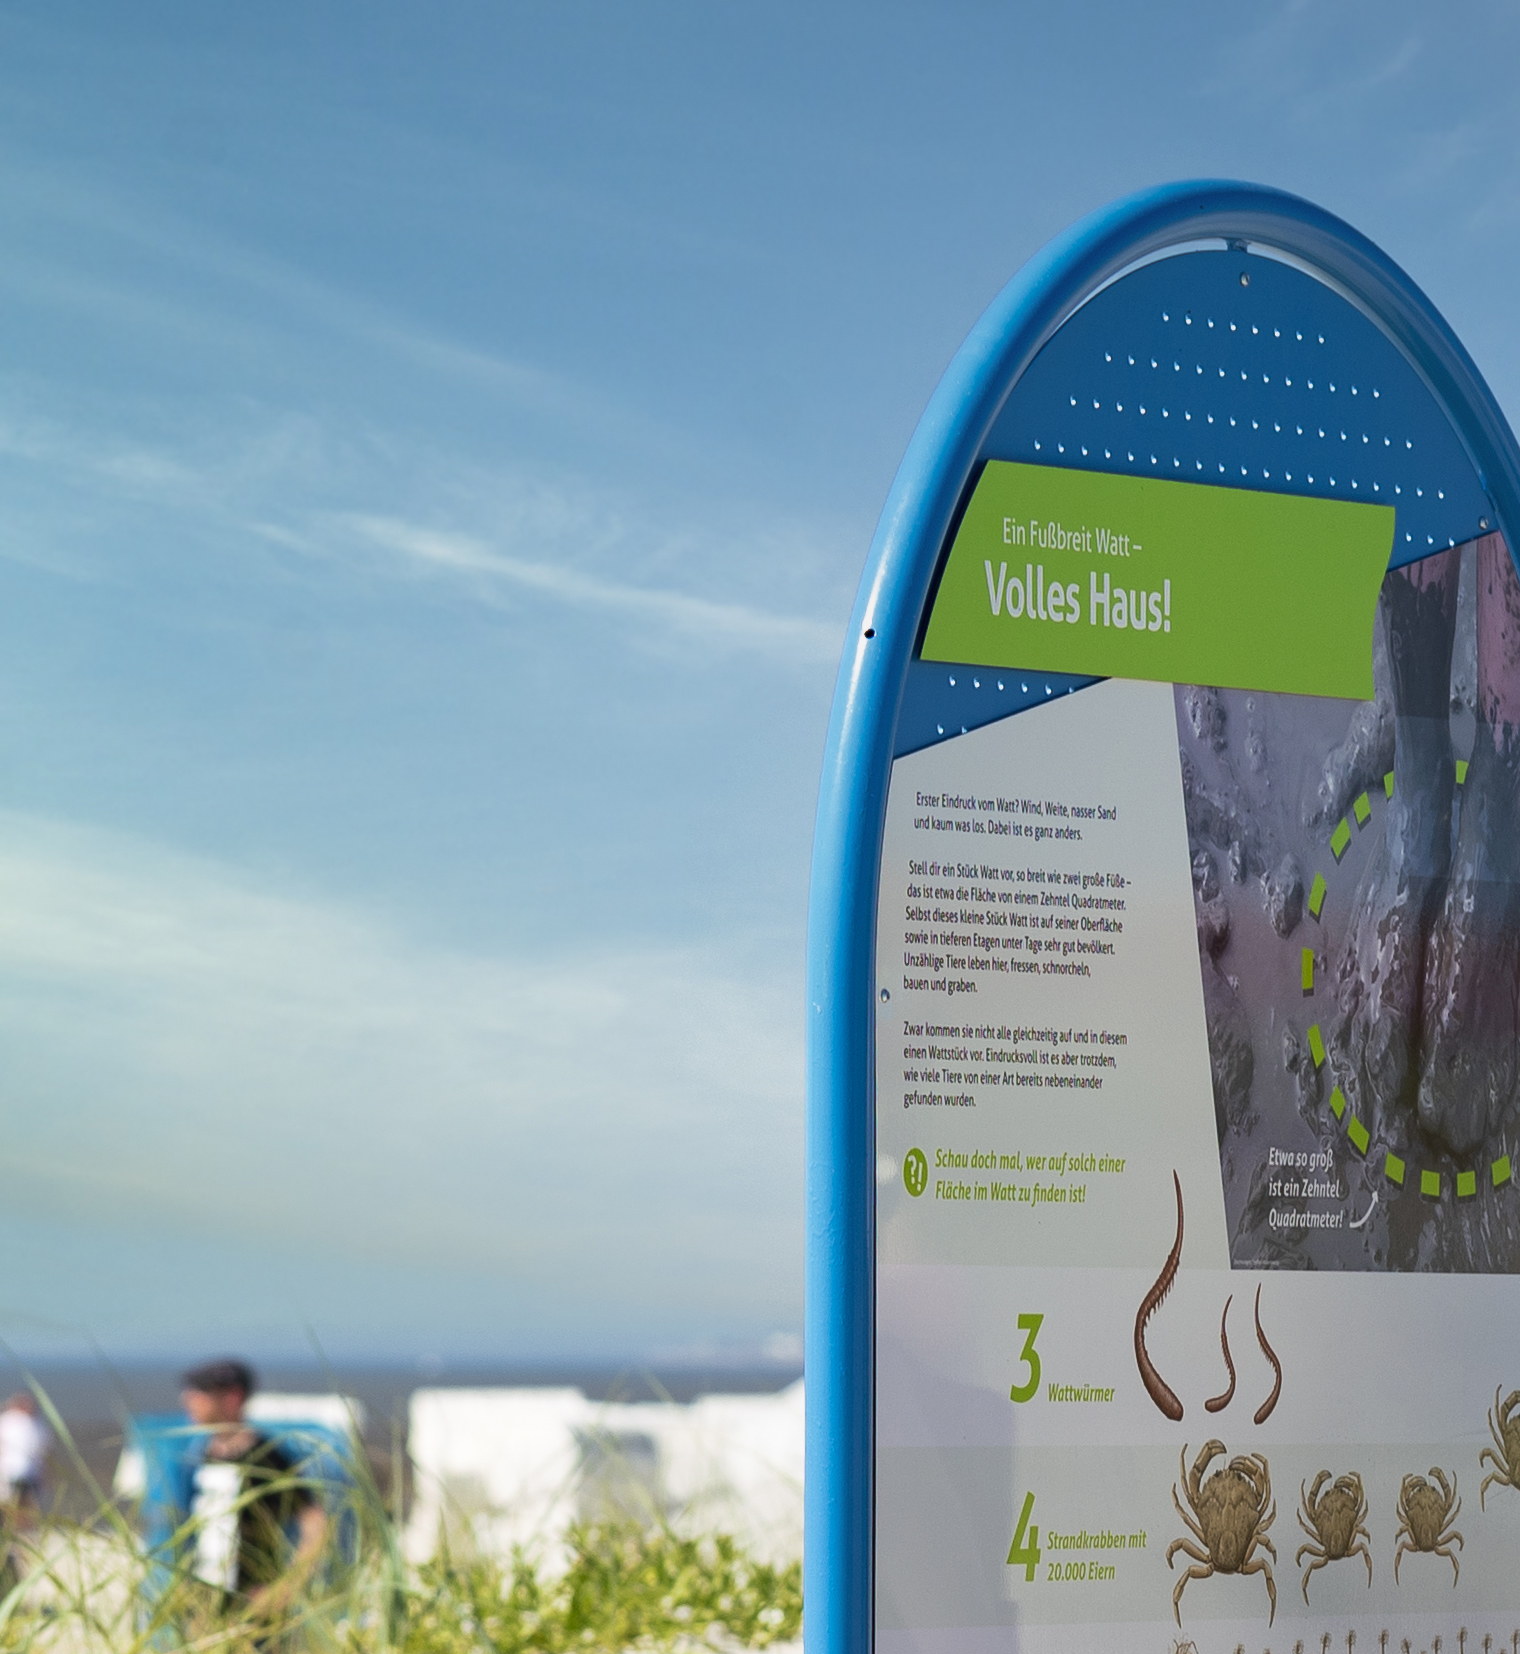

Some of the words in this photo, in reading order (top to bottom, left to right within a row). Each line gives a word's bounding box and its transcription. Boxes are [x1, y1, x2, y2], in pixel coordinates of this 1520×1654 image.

[1002, 516, 1026, 545] Ein
[1030, 520, 1092, 554] Fußbreit
[1095, 527, 1130, 557] Watt
[984, 560, 1080, 623] Volles
[1089, 571, 1171, 632] Haus!
[916, 792, 940, 807] Erster
[942, 794, 976, 810] Eindruck
[977, 800, 995, 811] vom
[996, 798, 1019, 813] Watt?
[1021, 800, 1043, 816] Wind,
[1045, 802, 1069, 818] Weite,
[1071, 807, 1096, 819] nasser
[1098, 805, 1116, 820] Sand
[914, 816, 930, 830] und
[931, 816, 954, 831] kaum
[955, 821, 971, 832] was
[972, 819, 986, 834] los.
[988, 820, 1011, 835] Dabei
[1012, 822, 1023, 836] ist
[1024, 826, 1033, 837] es
[1035, 827, 1053, 841] ganz
[1055, 826, 1082, 840] anders.
[909, 860, 928, 875] Stell
[929, 862, 941, 876] dir
[942, 862, 955, 877] ein
[957, 863, 979, 879] Stück
[980, 865, 999, 880] Watt
[1000, 870, 1015, 883] vor,
[1016, 871, 1025, 882] so
[1027, 868, 1046, 883] breit
[1047, 870, 1061, 884] wie
[1063, 872, 1081, 885] zwei
[1082, 873, 1105, 890] große
[1106, 874, 1125, 888] Füße
[907, 883, 922, 898] das
[923, 884, 933, 899] ist
[934, 888, 954, 900] etwa
[956, 887, 969, 901] die
[971, 887, 996, 903] Fläche
[997, 893, 1012, 903] von
[1014, 891, 1039, 905] einem
[1040, 892, 1070, 907] Zehntel
[1071, 894, 1126, 910] Quadratmeter.
[906, 906, 931, 922] Selbst
[932, 908, 958, 923] dieses
[960, 910, 985, 925] kleine
[986, 911, 1008, 926] Stück
[1009, 913, 1028, 927] Watt
[1029, 914, 1039, 928] ist
[1040, 915, 1054, 929] auf
[1055, 916, 1079, 930] seiner
[1081, 917, 1123, 933] Oberfläche
[904, 930, 928, 944] sowie
[930, 930, 938, 944] in
[940, 931, 972, 946] tieferen
[973, 933, 1000, 952] Etagen
[1002, 938, 1023, 949] unter
[1024, 936, 1042, 954] Tage
[1044, 938, 1061, 951] sehr
[1062, 942, 1076, 956] gut
[1077, 940, 1115, 955] bevölkert.
[904, 953, 944, 972] Unzählige
[946, 954, 966, 969] Tiere
[968, 956, 990, 970] leben
[992, 957, 1009, 973] hier,
[1011, 958, 1041, 975] fressen,
[1043, 961, 1091, 977] schnorcheln,
[903, 975, 929, 990] bauen
[930, 977, 946, 991] und
[948, 978, 977, 996] graben.
[903, 1021, 924, 1036] Zwar
[925, 1023, 960, 1037] kommen
[962, 1024, 973, 1038] sie
[975, 1025, 995, 1039] nicht
[996, 1026, 1011, 1040] alle
[1013, 1027, 1058, 1046] gleichzeitig
[1059, 1029, 1072, 1043] auf
[1073, 1030, 1088, 1044] und
[1090, 1030, 1098, 1043] in
[1099, 1031, 1127, 1045] diesem
[903, 1045, 927, 1059] einen
[928, 1046, 968, 1061] Wattstück
[969, 1051, 984, 1062] vor.
[986, 1048, 1038, 1064] Eindrucksvoll
[1039, 1050, 1049, 1065] ist
[1050, 1054, 1060, 1065] es
[1061, 1052, 1079, 1066] aber
[1080, 1053, 1116, 1068] trotzdem,
[903, 1067, 918, 1082] wie
[920, 1068, 940, 1083] viele
[942, 1069, 962, 1084] Tiere
[963, 1073, 979, 1084] von
[980, 1071, 1001, 1085] einer
[1002, 1072, 1014, 1086] Art
[1016, 1072, 1043, 1087] bereits
[1044, 1074, 1102, 1089] nebeneinander
[904, 1091, 942, 1109] gefunden
[944, 1093, 976, 1107] wurden.
[935, 1149, 968, 1168] Schau
[970, 1150, 997, 1169] doch
[999, 1152, 1023, 1172] mal,
[1026, 1156, 1047, 1170] wer
[1048, 1153, 1067, 1176] auf
[1068, 1153, 1096, 1172] solch
[1098, 1154, 1125, 1173] einer
[1268, 1147, 1294, 1166] Etwa
[1295, 1154, 1308, 1166] so
[1309, 1149, 1334, 1172] groß
[936, 1181, 971, 1200] Fläche
[974, 1182, 988, 1200] im
[990, 1182, 1016, 1201] Watt
[1018, 1188, 1031, 1202] zu
[1031, 1183, 1066, 1207] finden
[1069, 1184, 1086, 1203] ist!
[1268, 1178, 1282, 1197] ist
[1284, 1178, 1300, 1197] ein
[1301, 1179, 1340, 1198] Zehntel
[1268, 1208, 1343, 1230] Quadratmeter!
[1010, 1313, 1044, 1403] 3
[1048, 1383, 1115, 1403] Wattwürmer
[1006, 1491, 1041, 1582] 4
[1047, 1529, 1126, 1550] Strandkrabben
[1128, 1530, 1147, 1549] mit
[1047, 1562, 1086, 1581] 20.000
[1088, 1562, 1115, 1581] Eiern
